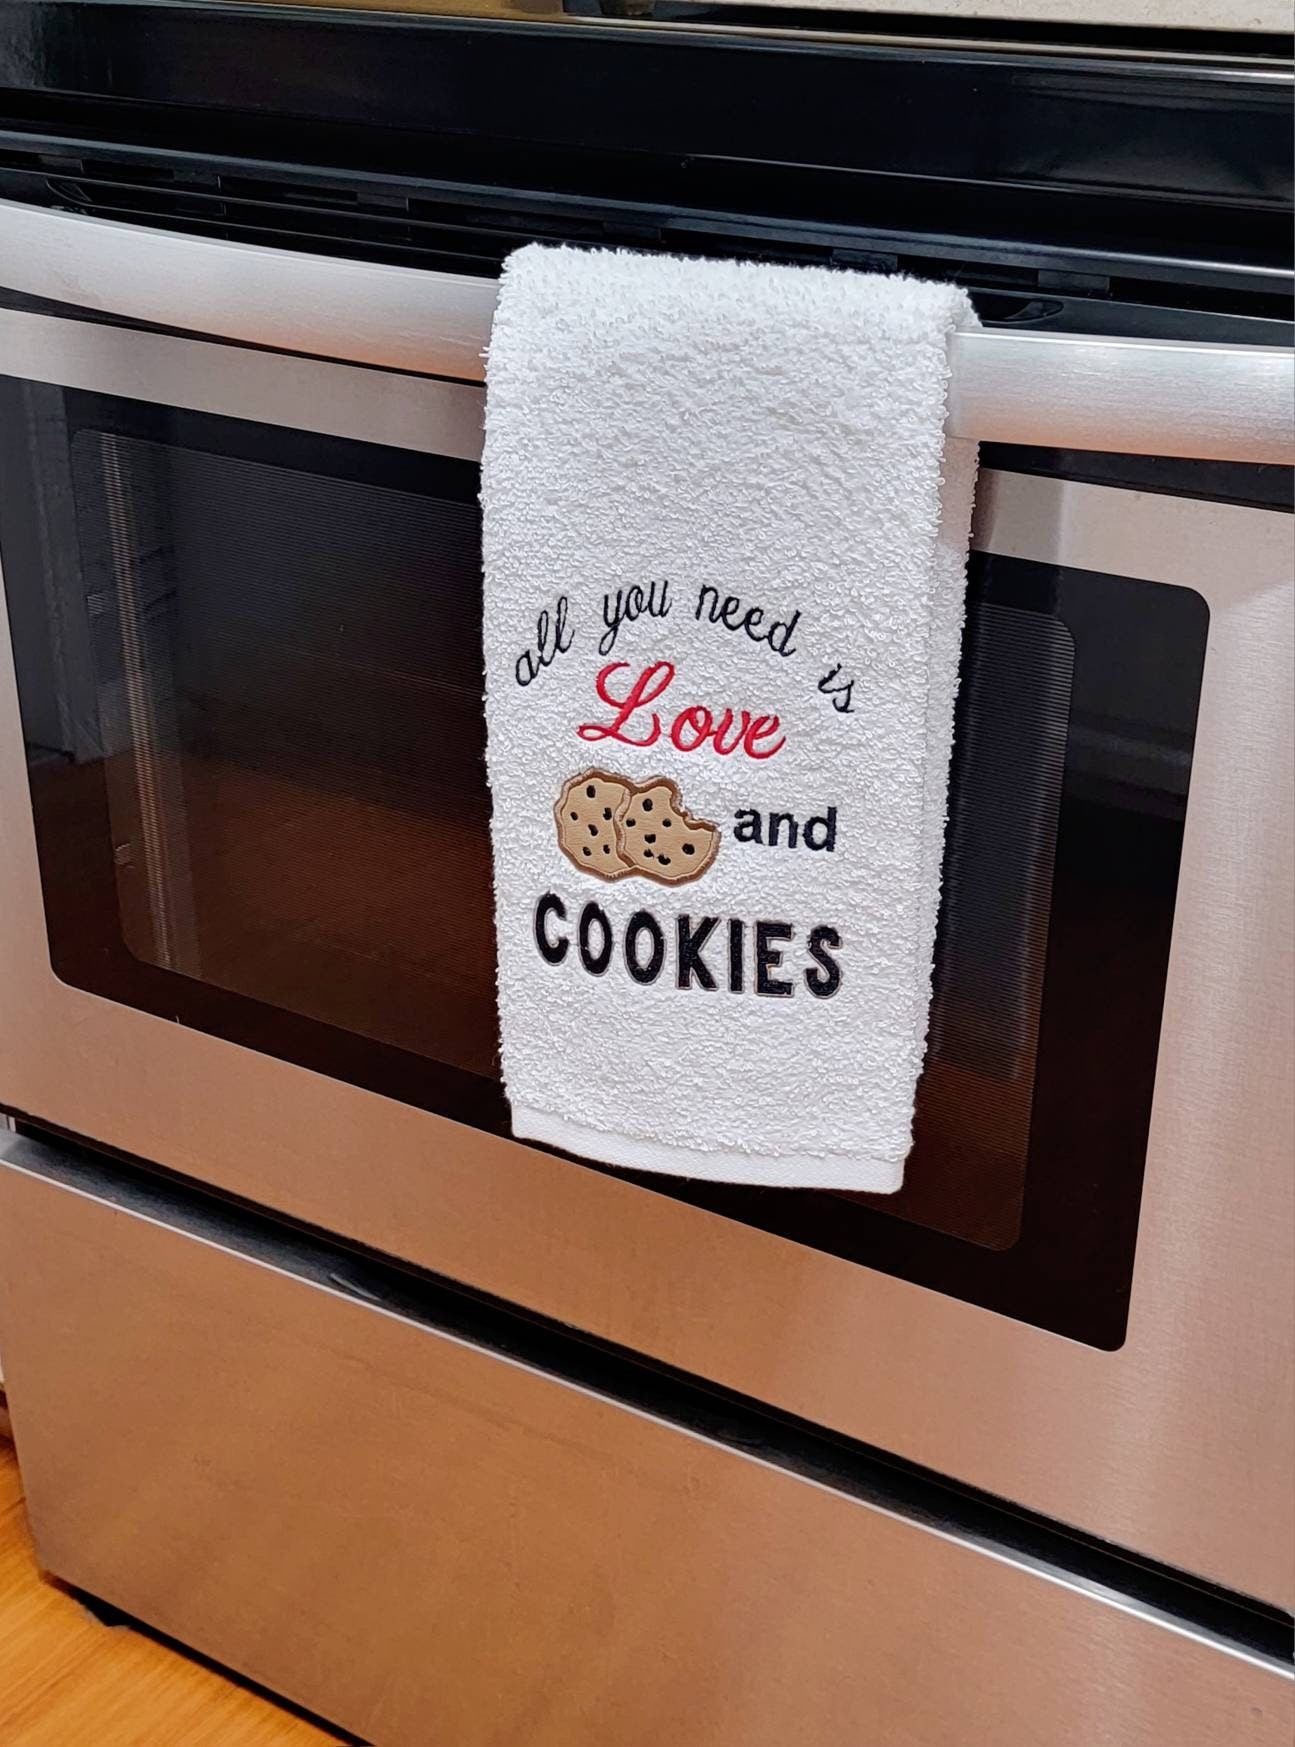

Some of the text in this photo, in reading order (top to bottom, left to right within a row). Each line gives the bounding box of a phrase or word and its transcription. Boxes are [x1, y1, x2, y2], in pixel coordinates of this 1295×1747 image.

[515, 579, 856, 714] all you need is
[576, 660, 786, 760] Love
[732, 806, 838, 853] and
[533, 890, 844, 1000] COOKIES
